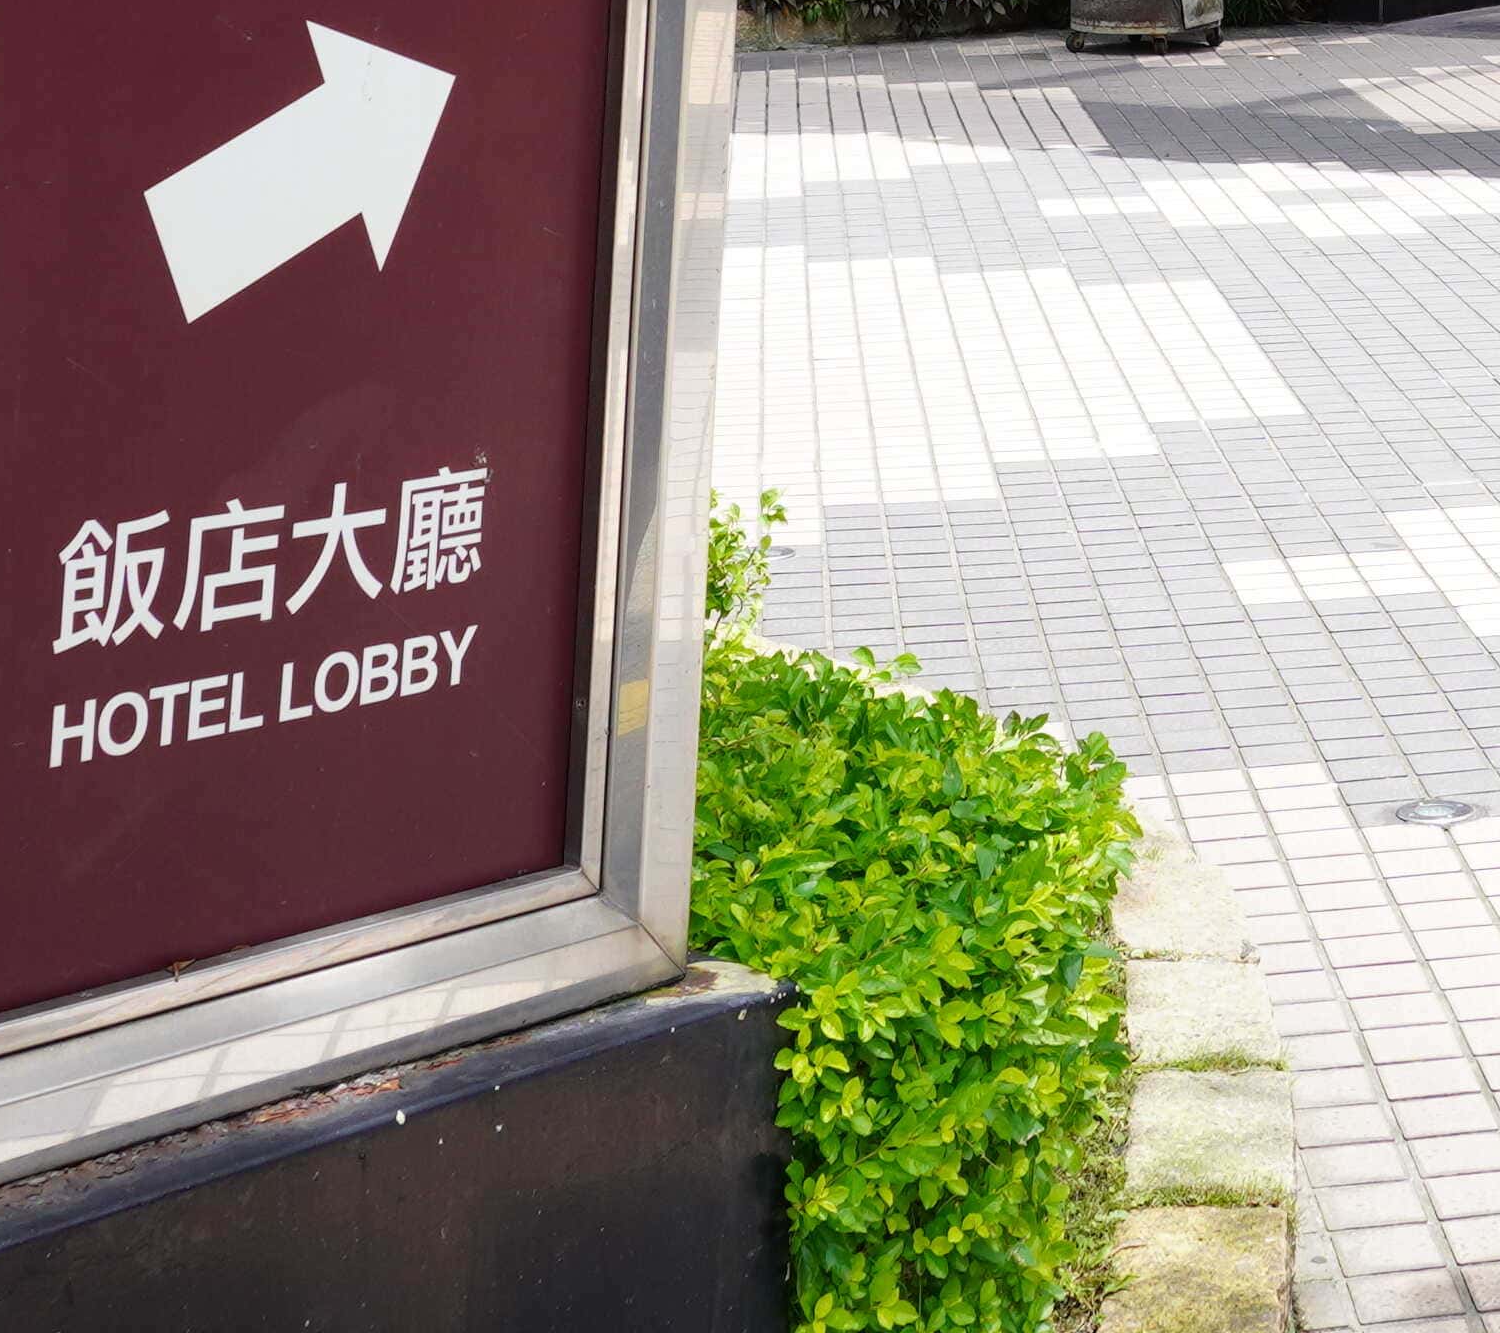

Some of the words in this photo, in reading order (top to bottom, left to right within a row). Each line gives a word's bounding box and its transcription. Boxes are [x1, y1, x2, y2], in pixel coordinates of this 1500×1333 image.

[52, 466, 488, 655] 飯店大廳
[49, 671, 264, 769] HOTEL
[279, 625, 478, 723] LOBBY
